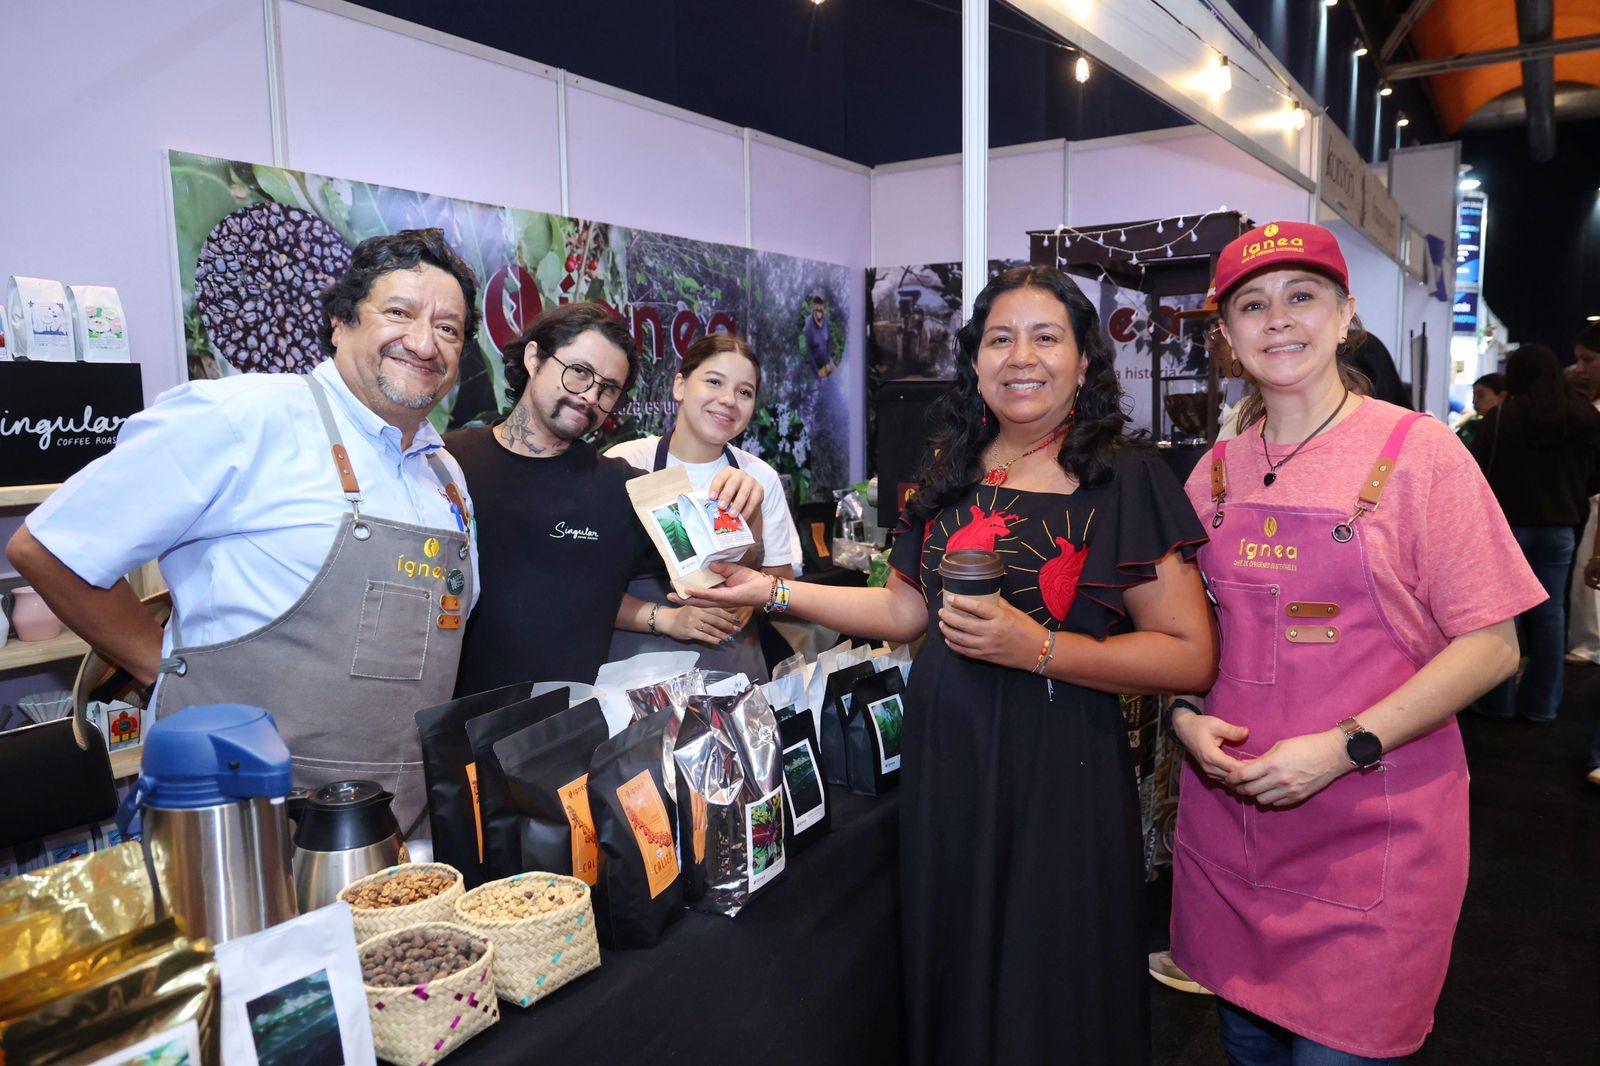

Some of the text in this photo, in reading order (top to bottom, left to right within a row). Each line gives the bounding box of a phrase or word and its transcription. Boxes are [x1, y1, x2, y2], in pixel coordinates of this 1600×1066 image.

[1125, 366, 1177, 380] histria
[0, 404, 128, 450] ingular
[57, 436, 117, 446] COFFEE ROAS
[549, 521, 600, 540] Singular
